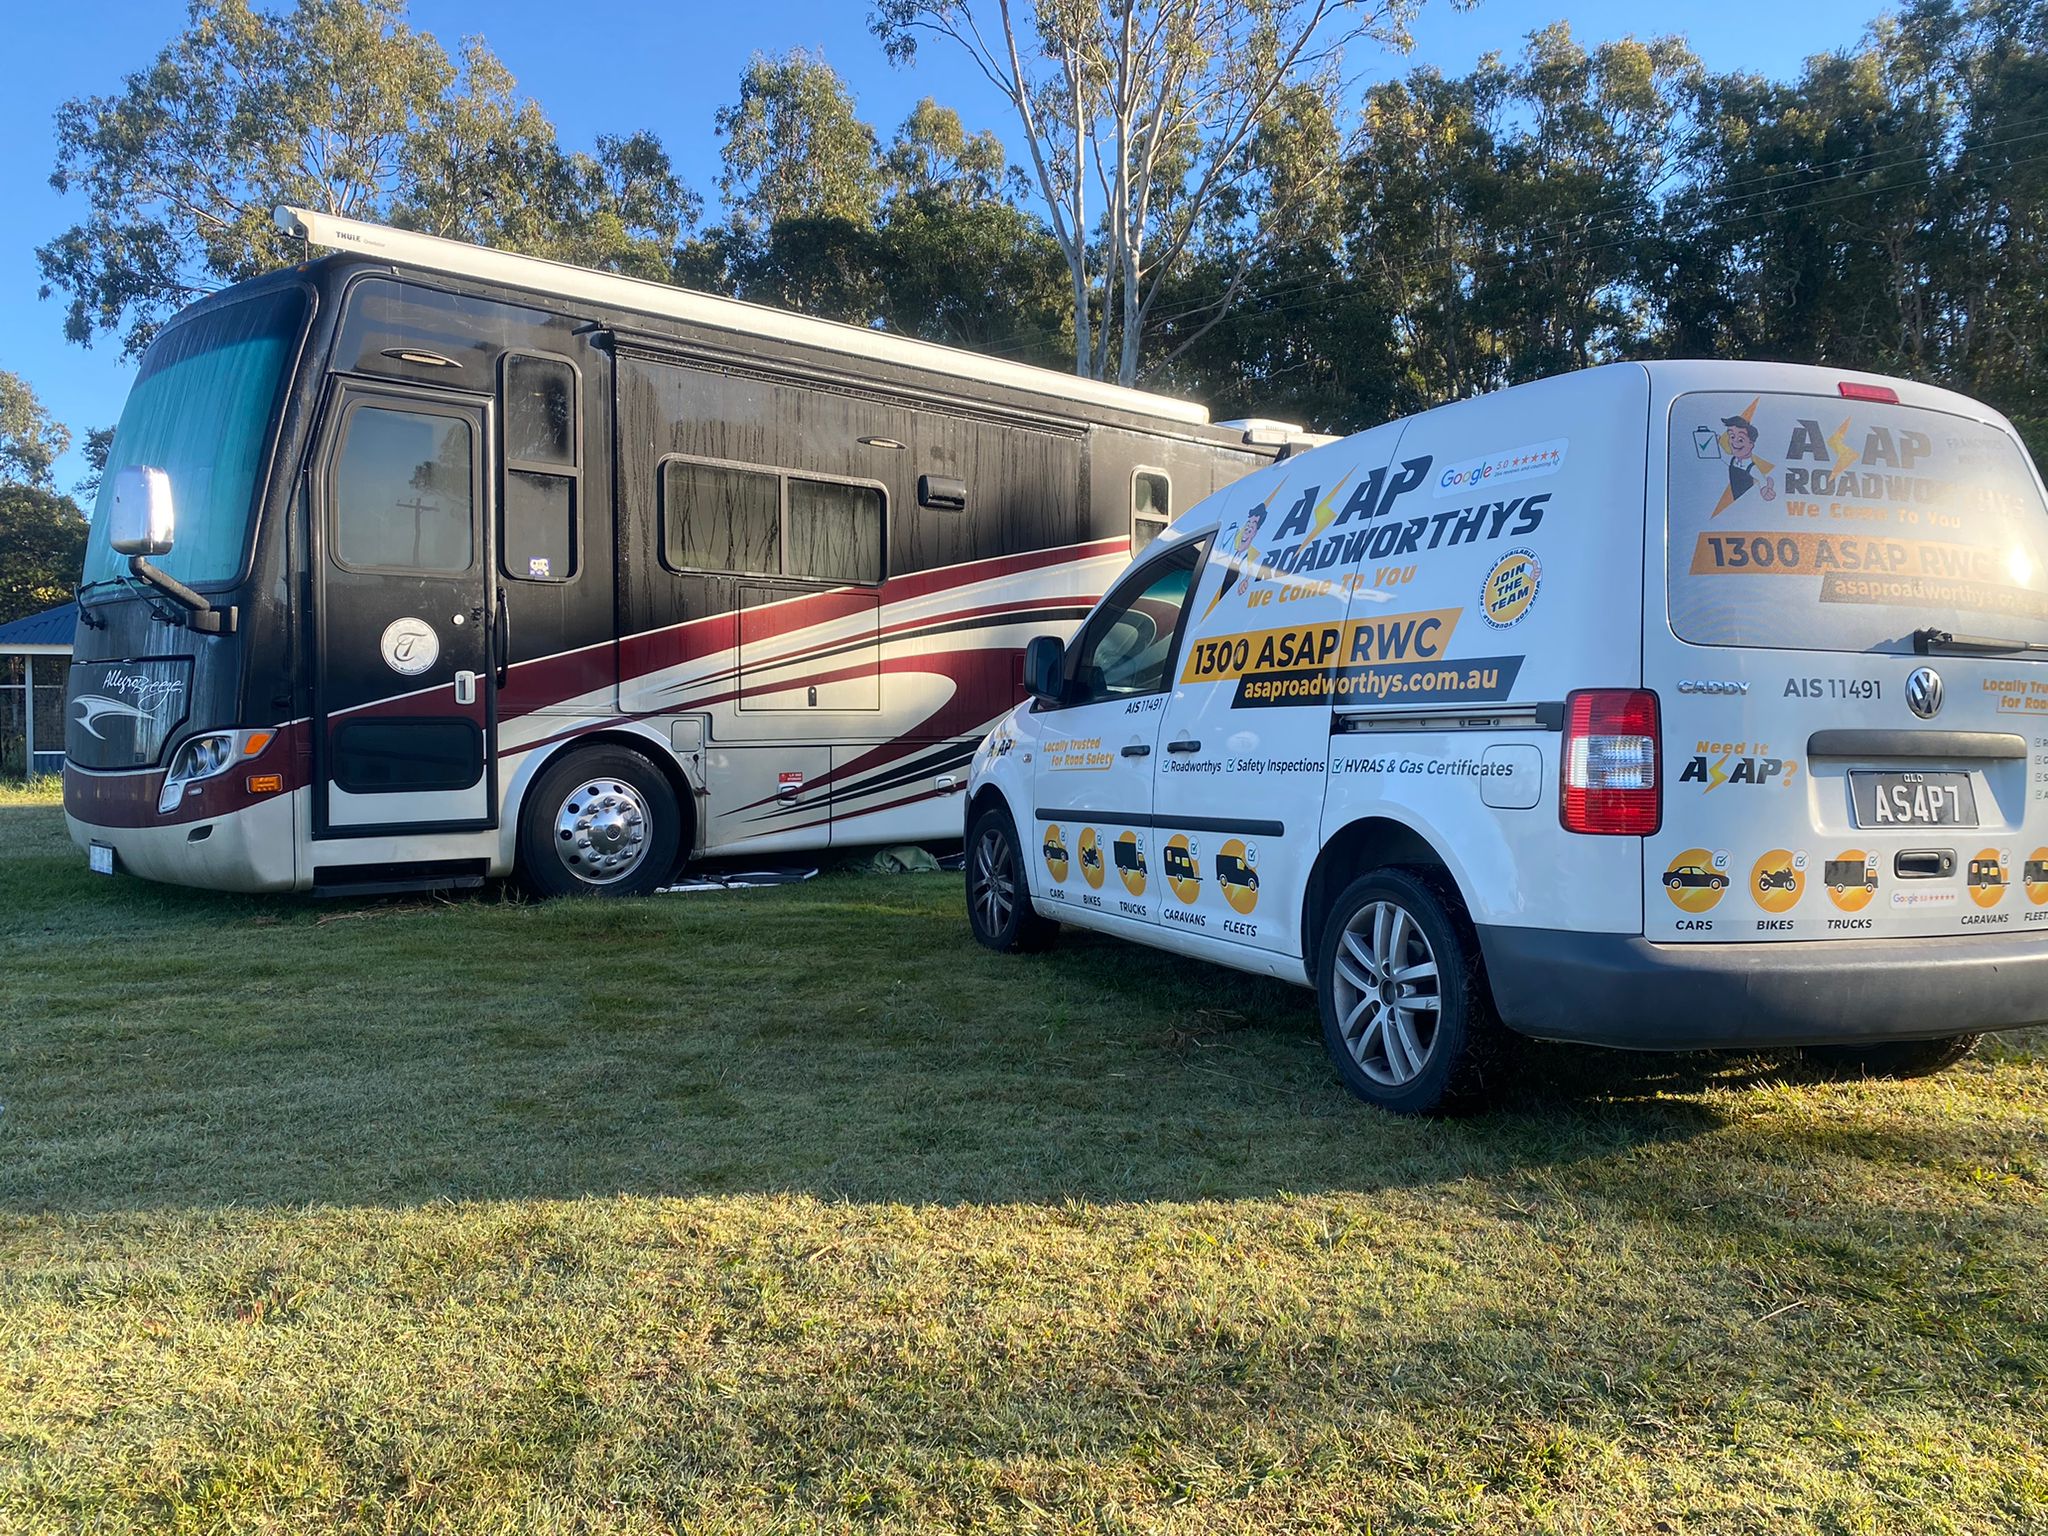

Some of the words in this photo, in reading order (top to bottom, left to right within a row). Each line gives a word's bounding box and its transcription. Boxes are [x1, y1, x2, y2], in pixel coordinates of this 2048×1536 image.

[336, 231, 361, 242] THULE
[1441, 462, 1492, 487] Google
[1787, 501, 1820, 517] We
[1255, 493, 1553, 582] ROADWORTHYS
[1708, 537, 1800, 568] 1300
[1814, 539, 1908, 572] ASAP
[1480, 562, 1498, 606] POSITIONS
[1500, 549, 1535, 563] AVAILABLE
[1493, 562, 1526, 587] JOIN
[1247, 589, 1272, 608] We
[1279, 580, 1332, 603] Come
[1341, 574, 1364, 593] To
[1374, 565, 1418, 588] You
[1497, 576, 1522, 597] THE
[1491, 585, 1529, 612] TEAM
[1483, 614, 1513, 629] YOURSELF
[1515, 609, 1528, 623] FOR
[1195, 638, 1249, 674] 1300
[1255, 629, 1340, 669] ASAP
[1350, 618, 1442, 662] RWC
[103, 669, 139, 694] Allegro
[128, 675, 184, 712] Breeze
[1244, 667, 1499, 701] asaproadworthys.com.au
[1677, 679, 1751, 696] CADDY
[1783, 678, 1824, 698] AIS
[1828, 679, 1881, 699] 11491
[1983, 679, 2028, 694] Locally
[1125, 702, 1141, 714] AIS
[1141, 698, 1163, 712] 11491
[2025, 697, 2048, 709] Roa
[1043, 740, 1069, 753] Locally
[1071, 737, 1102, 751] Trusted
[1696, 741, 1746, 755] Need
[1065, 754, 1085, 766] Road
[1086, 752, 1114, 766] Safety
[1237, 759, 1266, 774] Safety
[1267, 758, 1325, 775] Inspections
[1344, 759, 1385, 773] HVRAS
[1386, 759, 1396, 773] &
[1399, 759, 1424, 774] Gas
[1427, 758, 1513, 776] Certificates
[1171, 760, 1222, 775] Roadworthys
[1903, 773, 1924, 783] QLD
[1876, 785, 1960, 822] AS4P7
[1050, 888, 1065, 899] CARS
[1083, 894, 1101, 906] BIKES
[1893, 893, 1918, 905] Google
[1119, 901, 1147, 916] TRUCKS
[2024, 911, 2048, 921] FLEET
[1164, 908, 1206, 927] CARAVANS
[1675, 920, 1713, 930] CARS
[1756, 920, 1794, 930] BIKES
[1827, 919, 1872, 929] TRUCKS
[1961, 914, 2009, 925] CARAVANS
[1223, 920, 1257, 937] FLEETS
